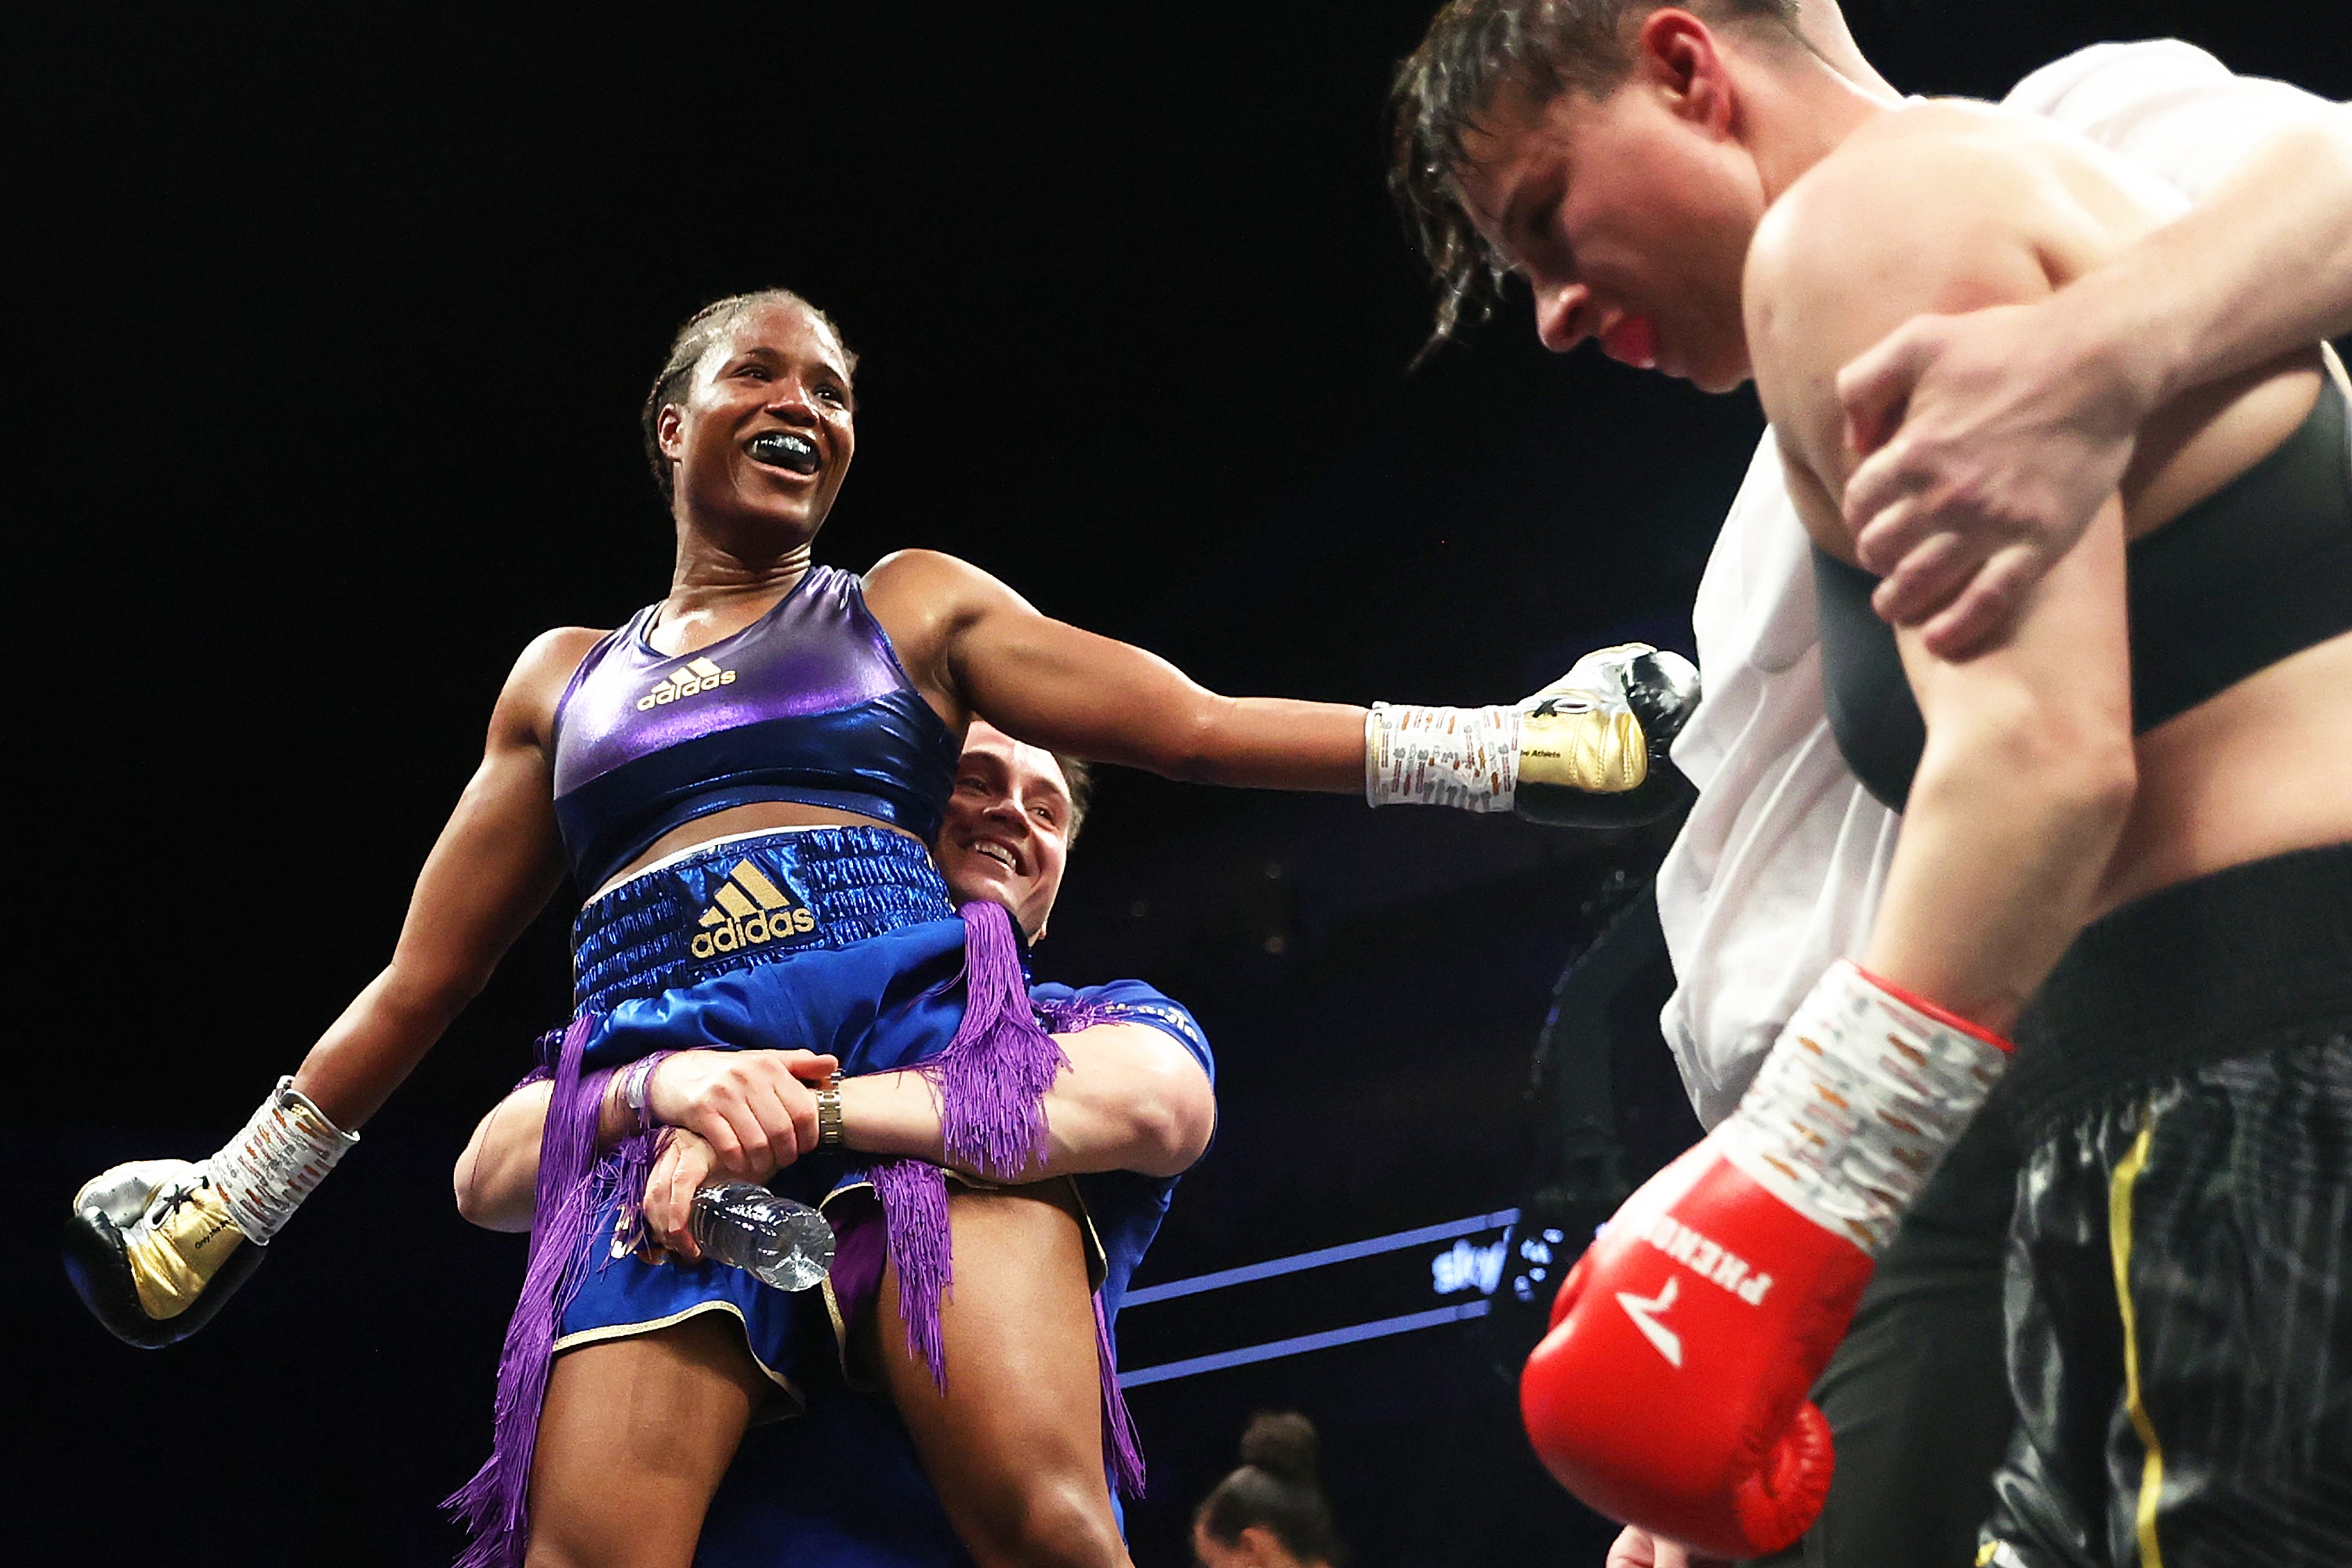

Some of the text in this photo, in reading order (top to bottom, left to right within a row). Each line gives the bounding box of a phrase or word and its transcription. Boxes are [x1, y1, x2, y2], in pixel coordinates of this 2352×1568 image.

[637, 670, 736, 711] adidas
[691, 907, 815, 959] adidas
[1432, 1232, 1511, 1294] sky
[1639, 1214, 1773, 1307] PHENO
